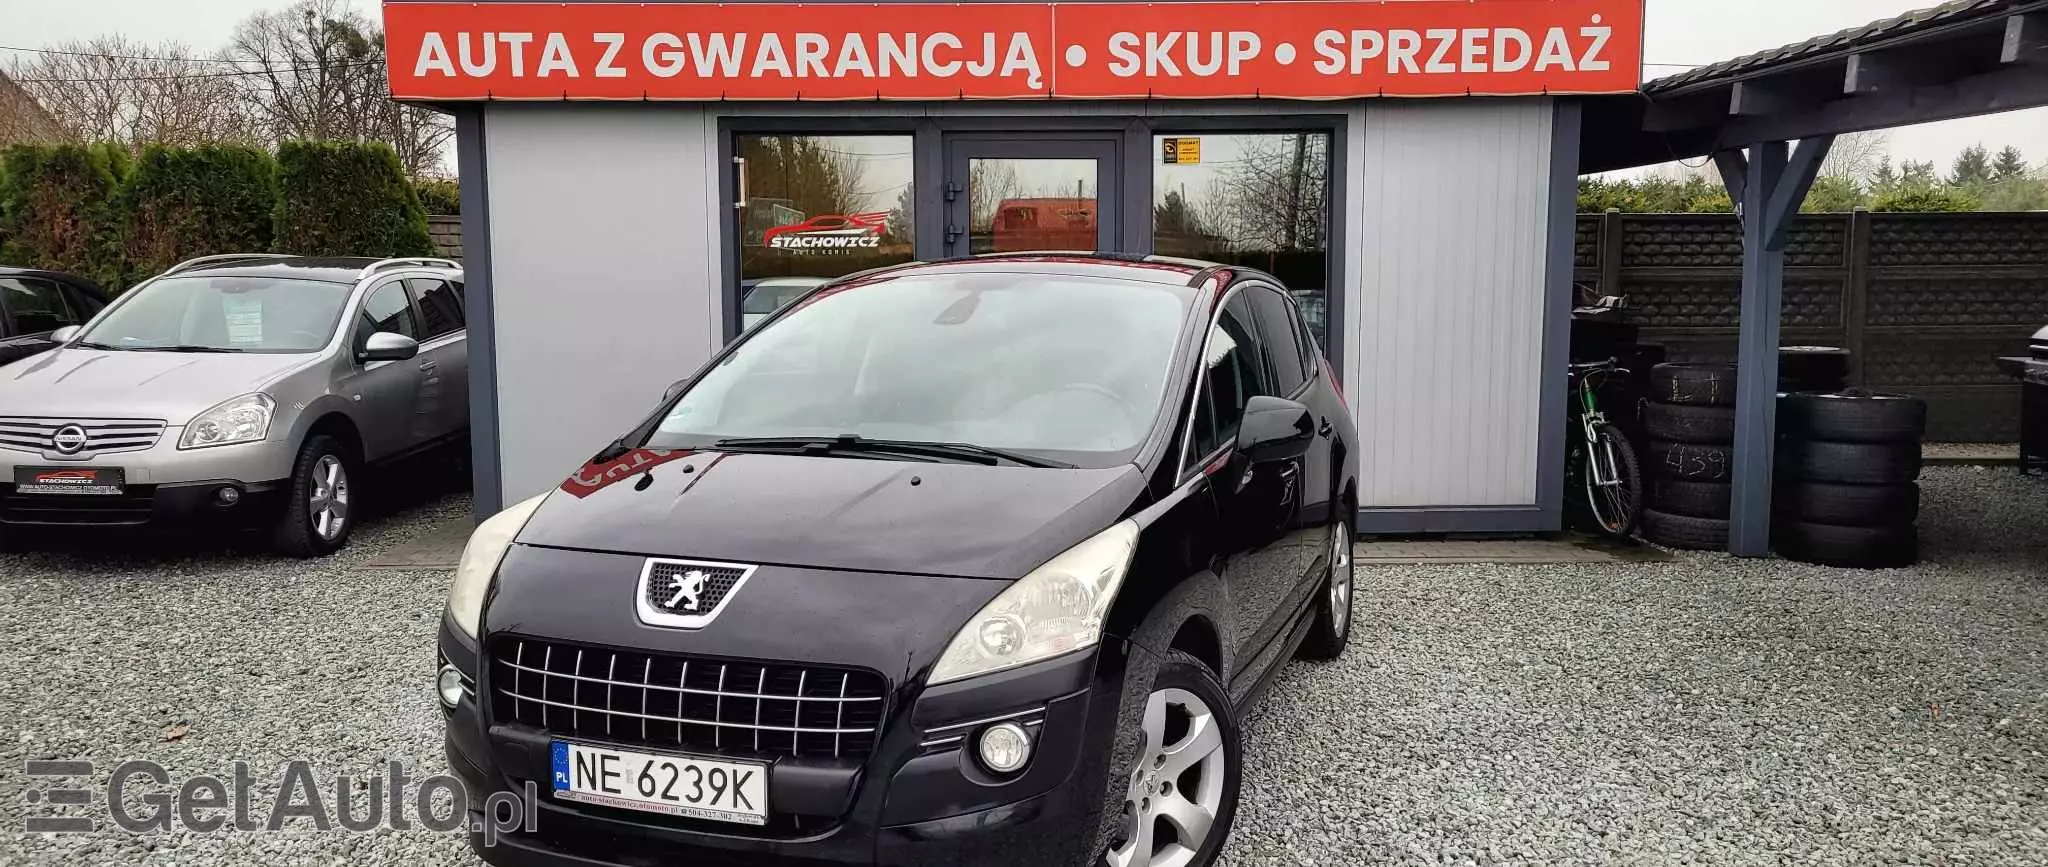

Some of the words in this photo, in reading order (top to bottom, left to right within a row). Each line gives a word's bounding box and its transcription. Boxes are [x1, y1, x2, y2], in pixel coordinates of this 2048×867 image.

[413, 32, 580, 78] AUTA
[594, 32, 627, 78] Z
[641, 31, 1044, 89] GWARANCJĄ
[1107, 31, 1262, 77] SKUP
[1312, 13, 1613, 76] SPRZEDAŻ
[770, 236, 880, 248] STACHOWICZ
[556, 771, 569, 783] PL
[576, 750, 622, 794] NE
[637, 759, 754, 811] 6239K
